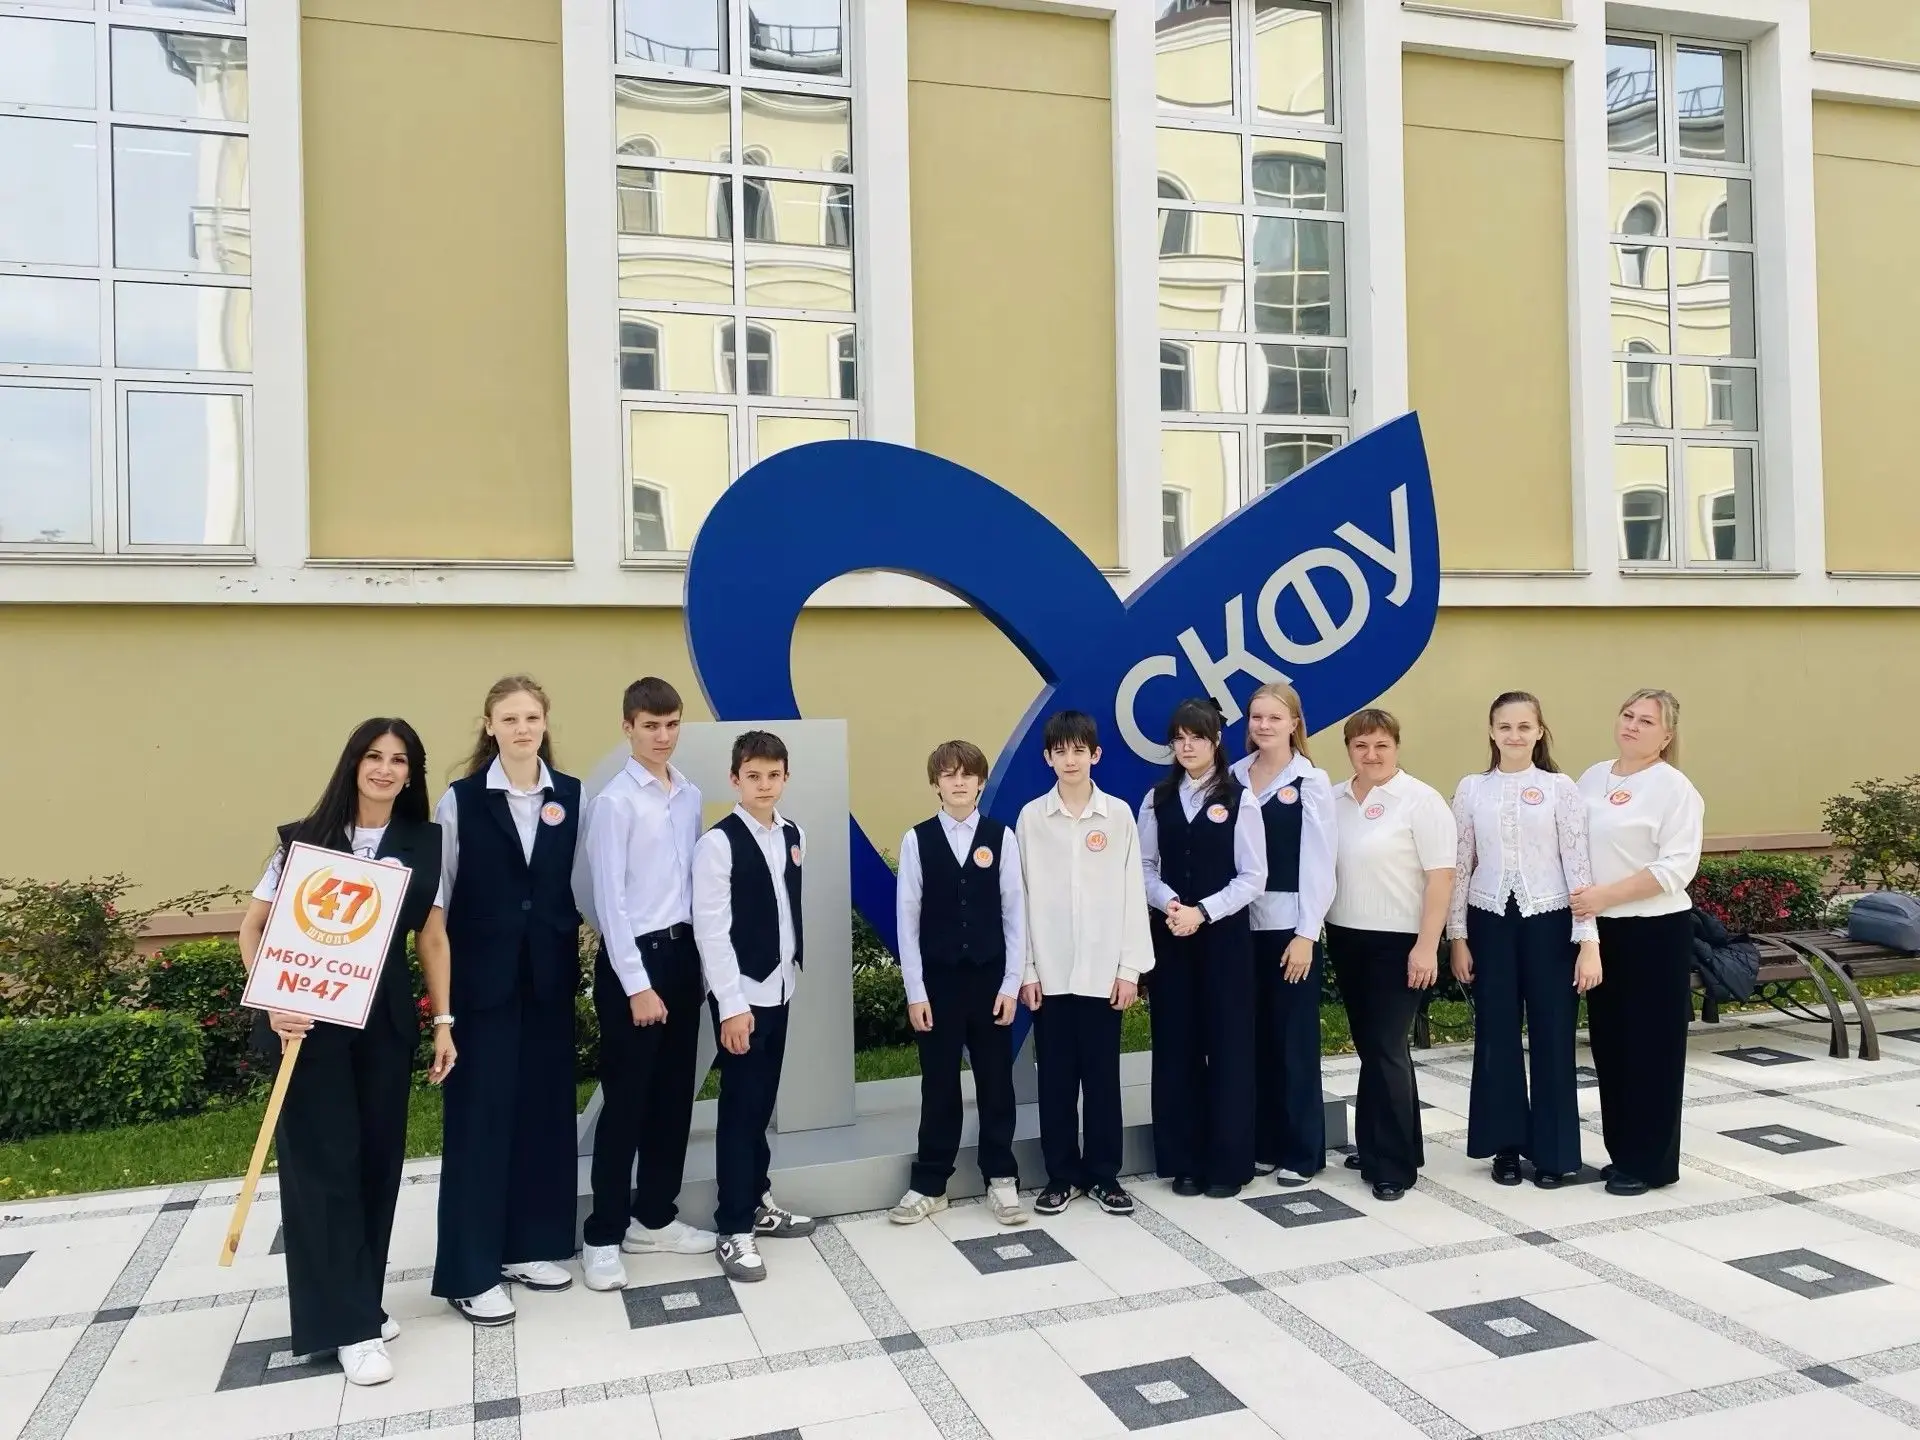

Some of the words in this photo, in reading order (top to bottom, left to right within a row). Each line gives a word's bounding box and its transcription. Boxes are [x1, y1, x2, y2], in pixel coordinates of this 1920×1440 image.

[1115, 483, 1412, 765] СКФУ
[308, 877, 374, 924] 47
[306, 926, 350, 944] ШКОЛА
[265, 946, 323, 969] МБОУ
[326, 959, 373, 980] СОШ
[276, 970, 349, 1002] №47
